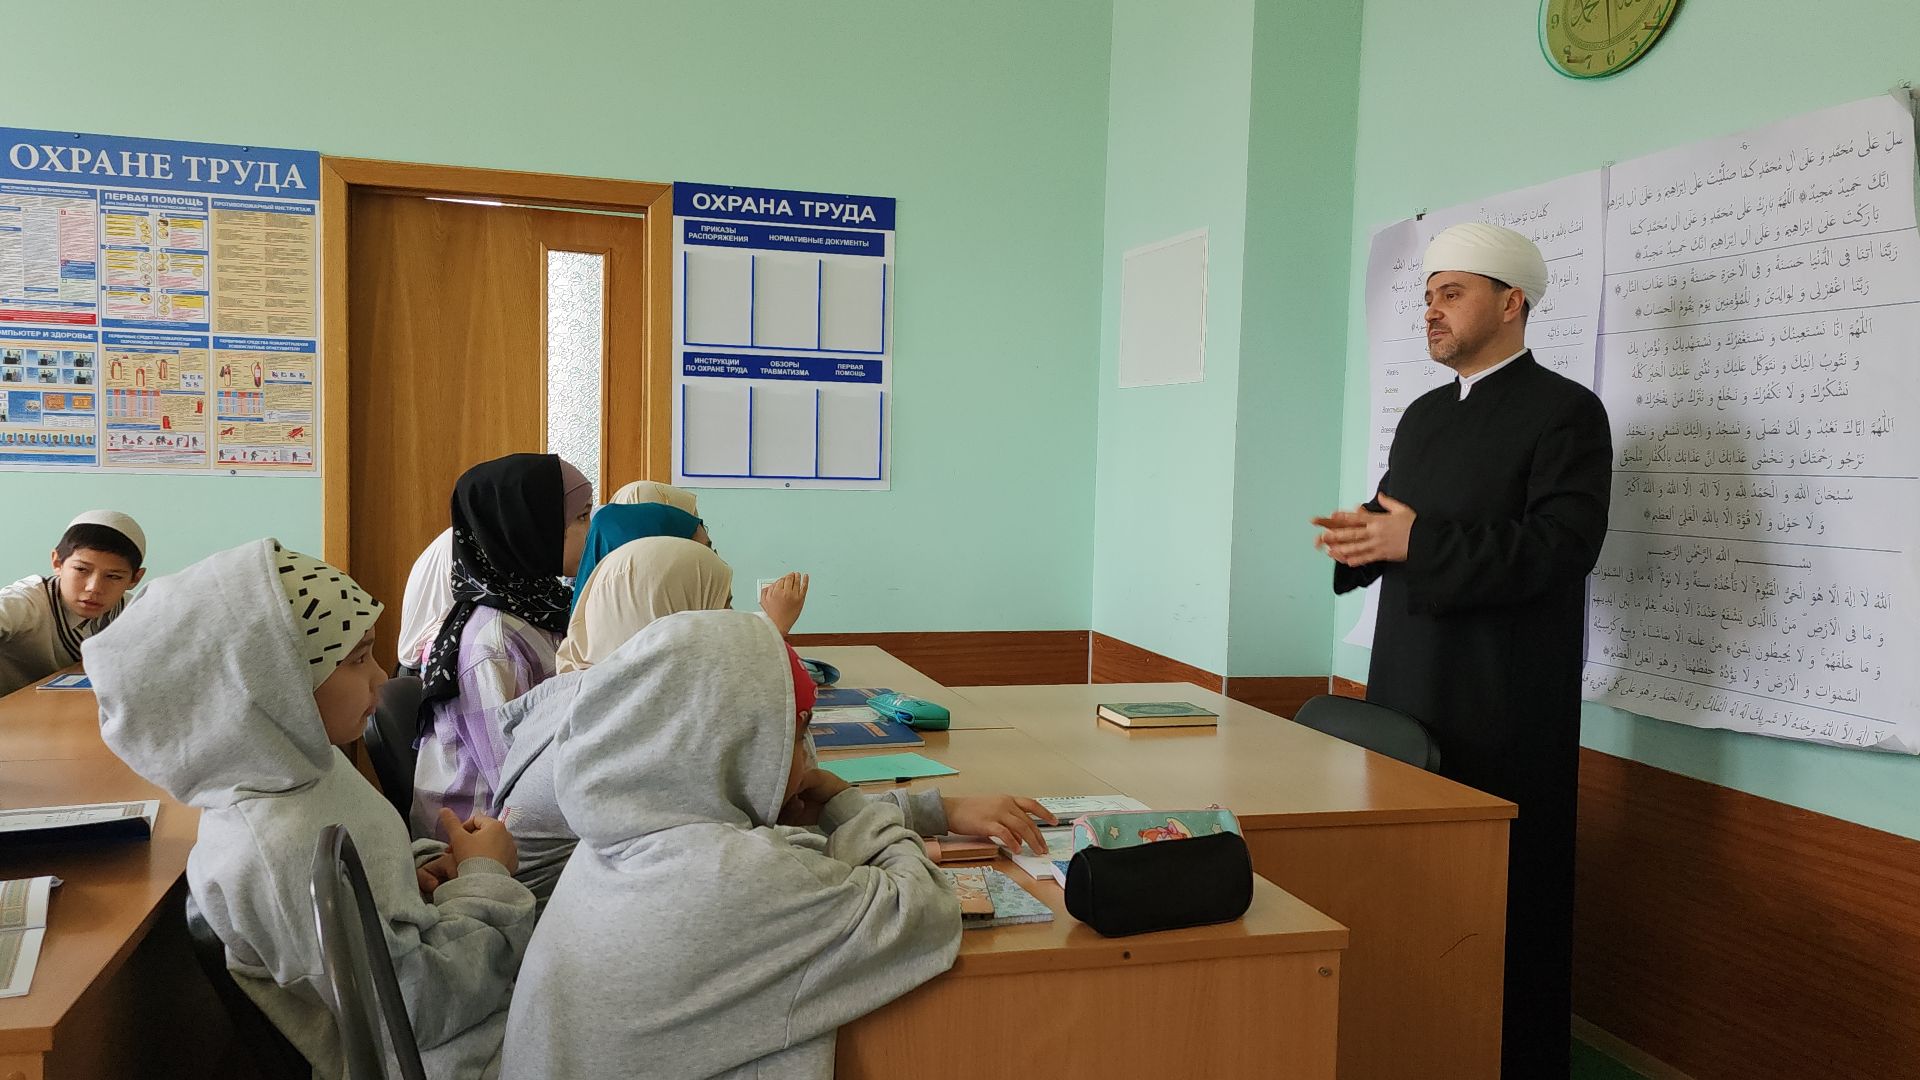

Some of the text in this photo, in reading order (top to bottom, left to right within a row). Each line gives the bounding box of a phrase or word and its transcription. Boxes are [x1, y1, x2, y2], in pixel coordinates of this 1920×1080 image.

[1607, 50, 1615, 65] 6
[9, 143, 307, 193] ОХРАНЕ ТРУДА
[105, 192, 148, 203] ПЕРВАЯ
[152, 195, 204, 207] ПОМОЩЬ
[692, 192, 877, 224] ОХРАНА ТРУДА
[701, 225, 736, 234] ПРИКАЗЫ
[688, 232, 749, 243] РАСПОРЯЖЕНИЯ
[769, 234, 870, 247] НОРМАТИВНЫЕ ДОКУМЕНТЫ
[51, 331, 94, 340] ЗДОРОВЬЕ
[694, 357, 740, 366] ИНСТРУКЦИИ
[770, 360, 800, 368] ОБЗОРЫ
[685, 364, 748, 375] ПО ОХРАНЕ ТРУДА
[760, 367, 810, 376] ТРАВМАТИЗМА
[835, 369, 866, 377] ПОМОЩЬ
